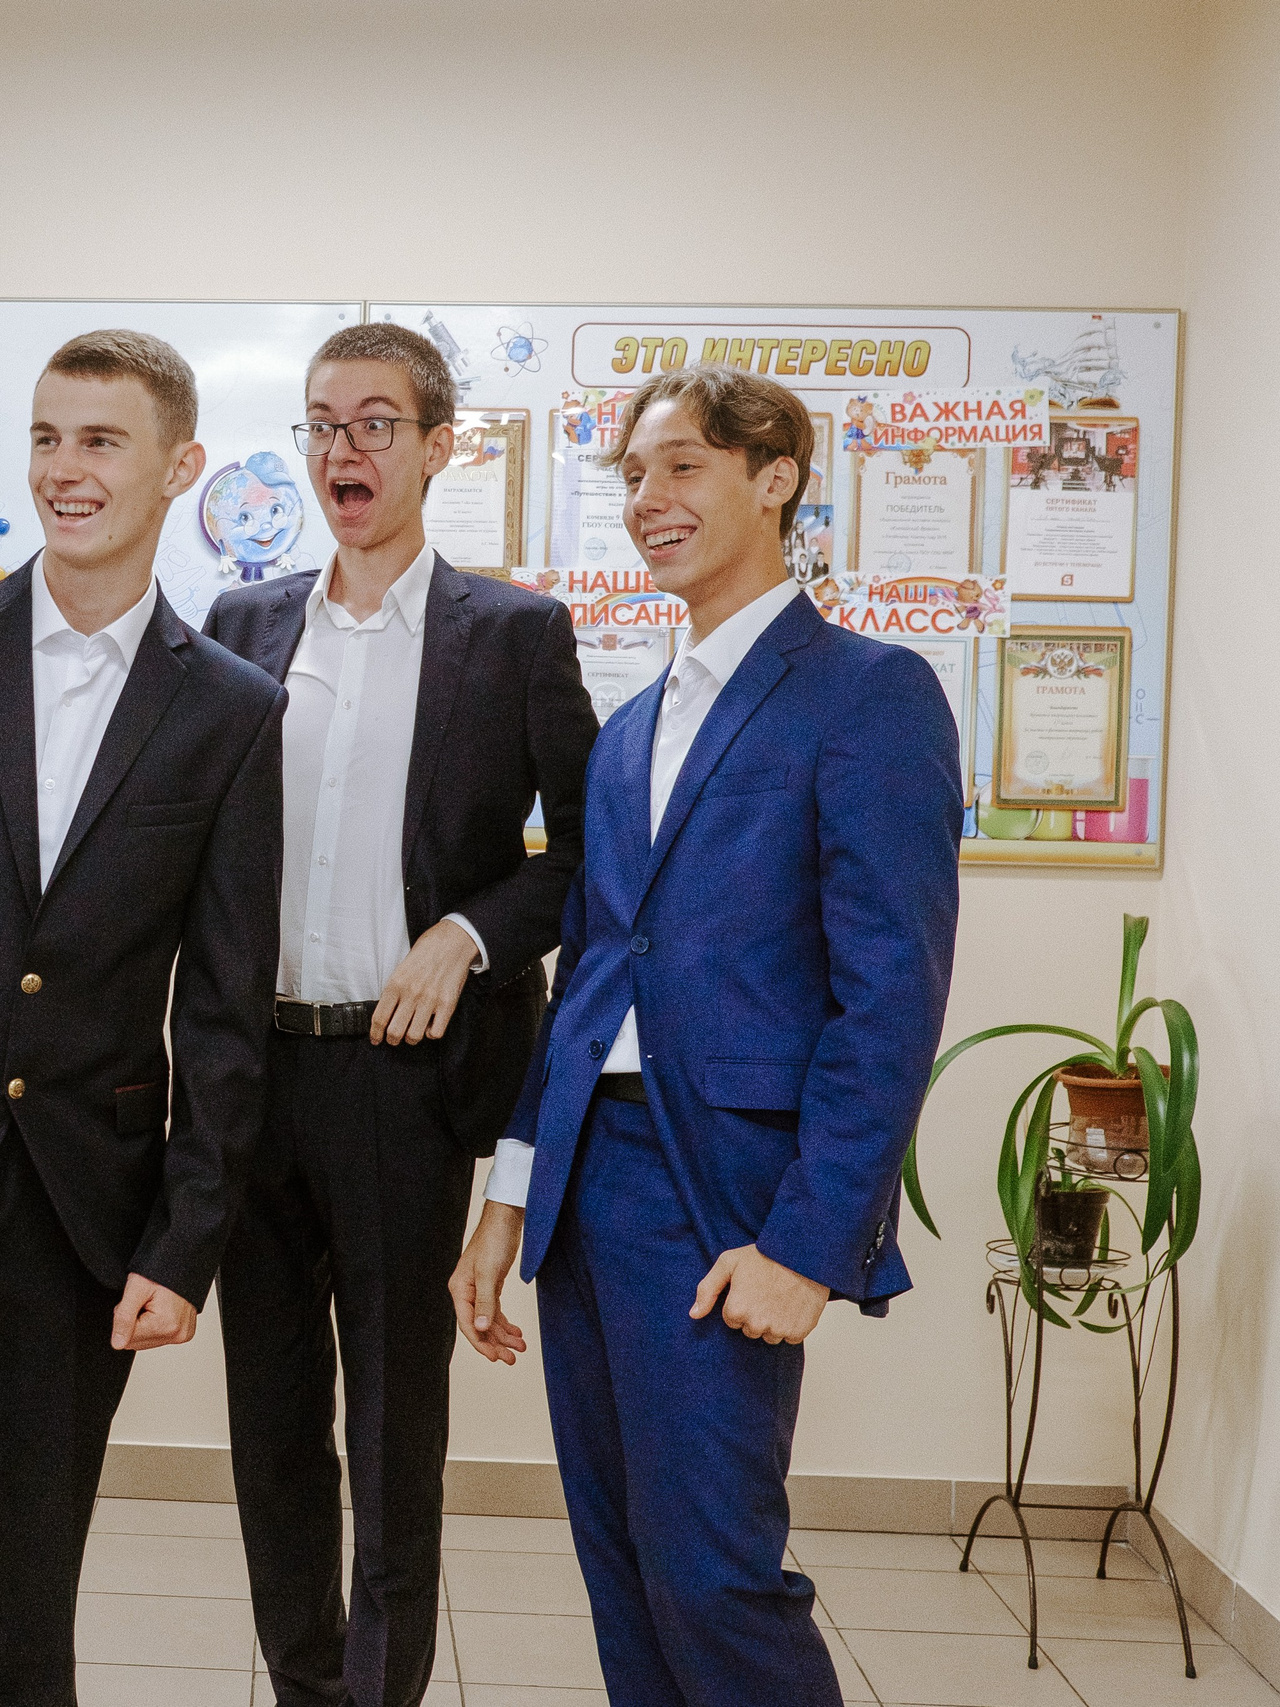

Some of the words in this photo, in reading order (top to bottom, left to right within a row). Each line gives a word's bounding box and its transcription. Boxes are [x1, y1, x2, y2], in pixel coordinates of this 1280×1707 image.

[611, 337, 688, 374] ЭТО
[702, 338, 932, 377] ИНТЕРЕСНО
[890, 400, 1027, 423] ВАЖНАЯ
[873, 424, 1043, 446] ИНФОРМАЦИЯ
[885, 471, 948, 488] Грамота
[886, 504, 945, 514] ПОБЕДИТЕЛЬ
[1046, 498, 1098, 506] СЕРТИФИКАТ
[568, 571, 658, 593] НАШЕ
[868, 584, 928, 604] НАШ
[570, 603, 689, 626] ПИСАНИ
[839, 607, 955, 634] КЛАСС
[931, 663, 956, 673] КАТ
[1036, 685, 1086, 695] ГРАМОТА
